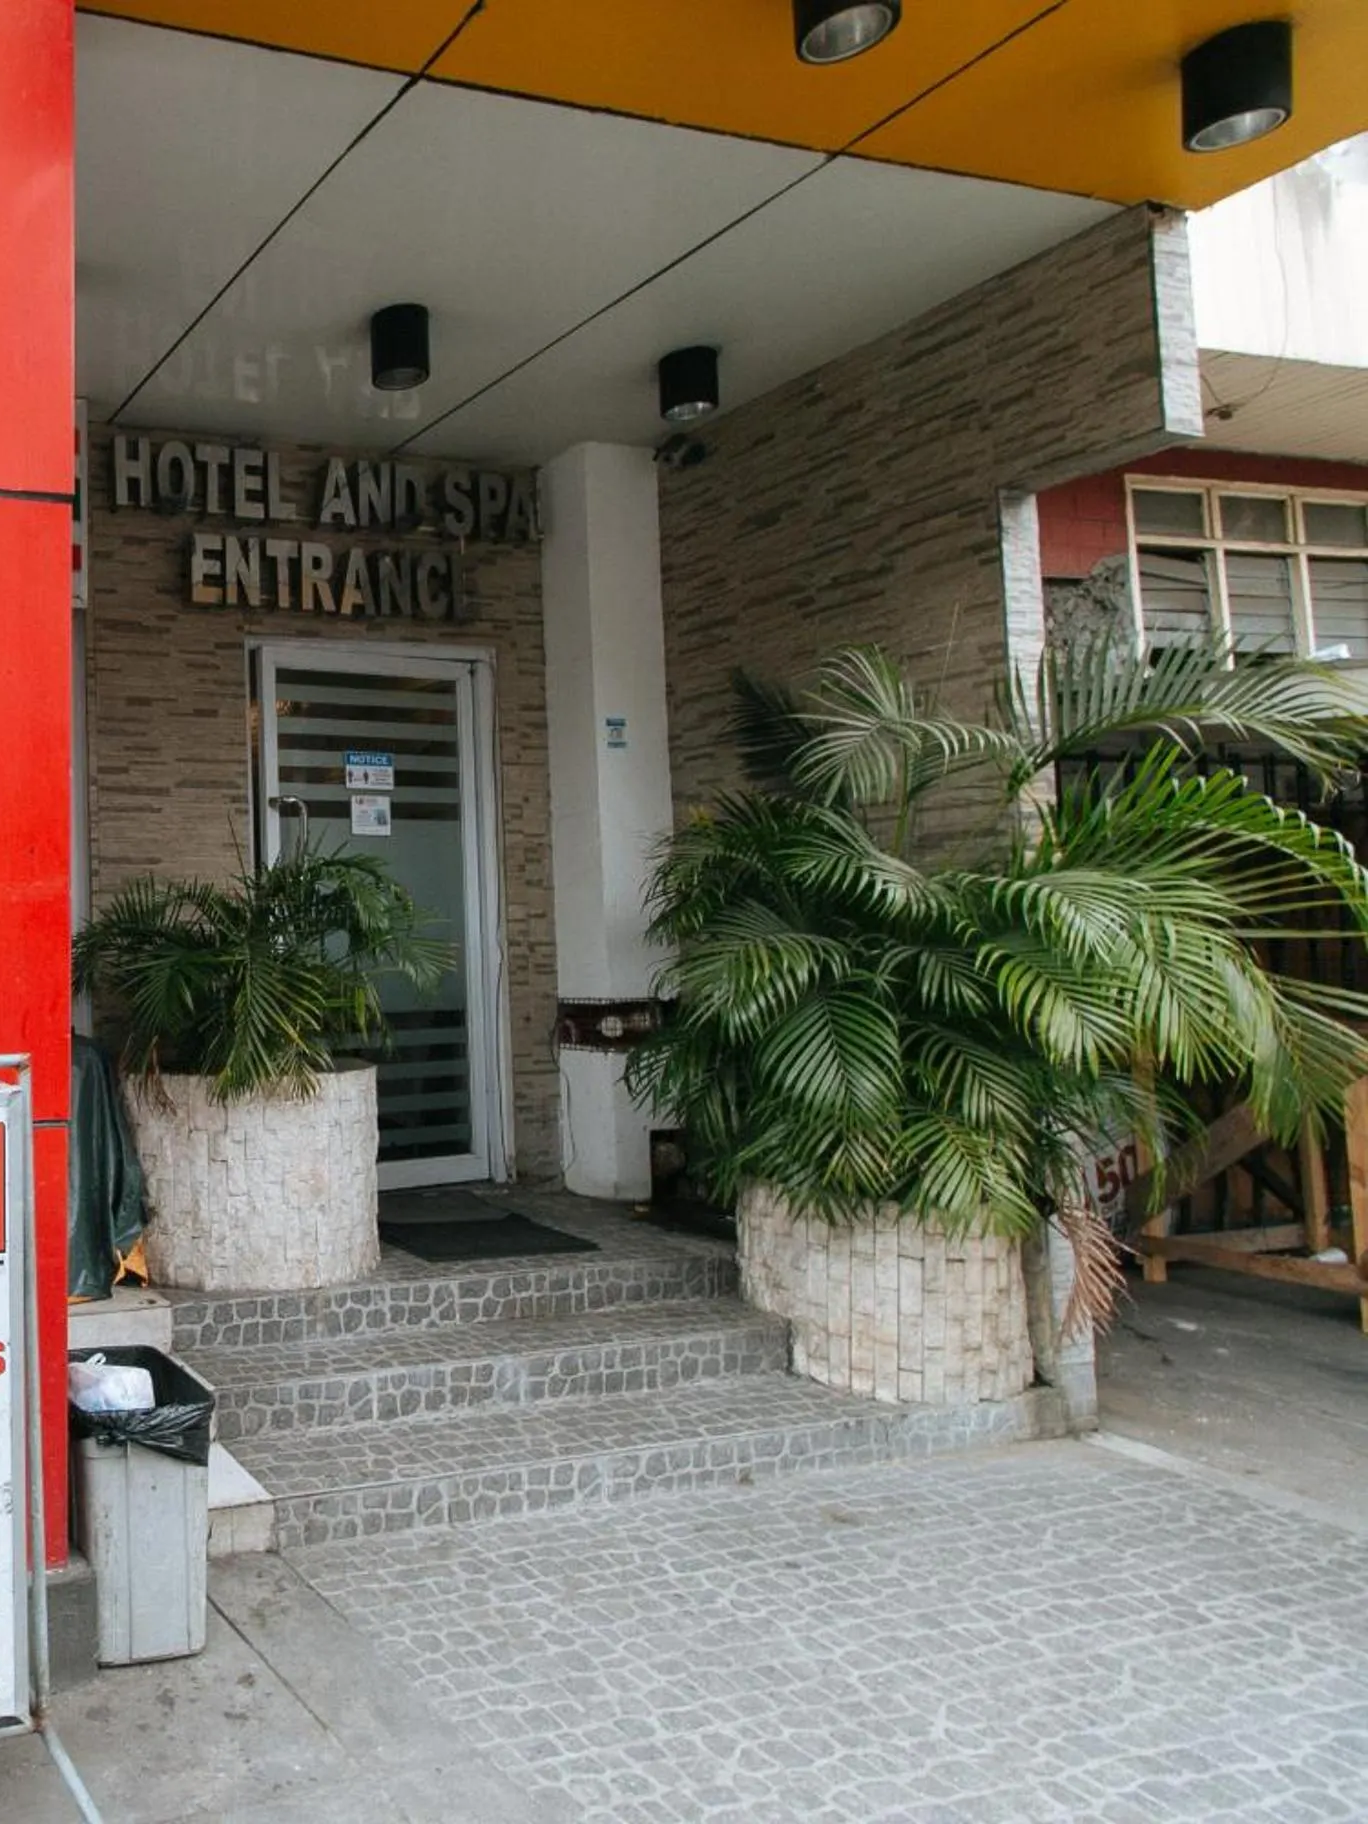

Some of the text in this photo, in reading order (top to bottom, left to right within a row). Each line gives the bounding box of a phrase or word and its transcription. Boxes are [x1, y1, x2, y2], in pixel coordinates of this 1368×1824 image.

[114, 435, 538, 543] HOTEL AND SPA
[349, 754, 389, 765] NOTICE
